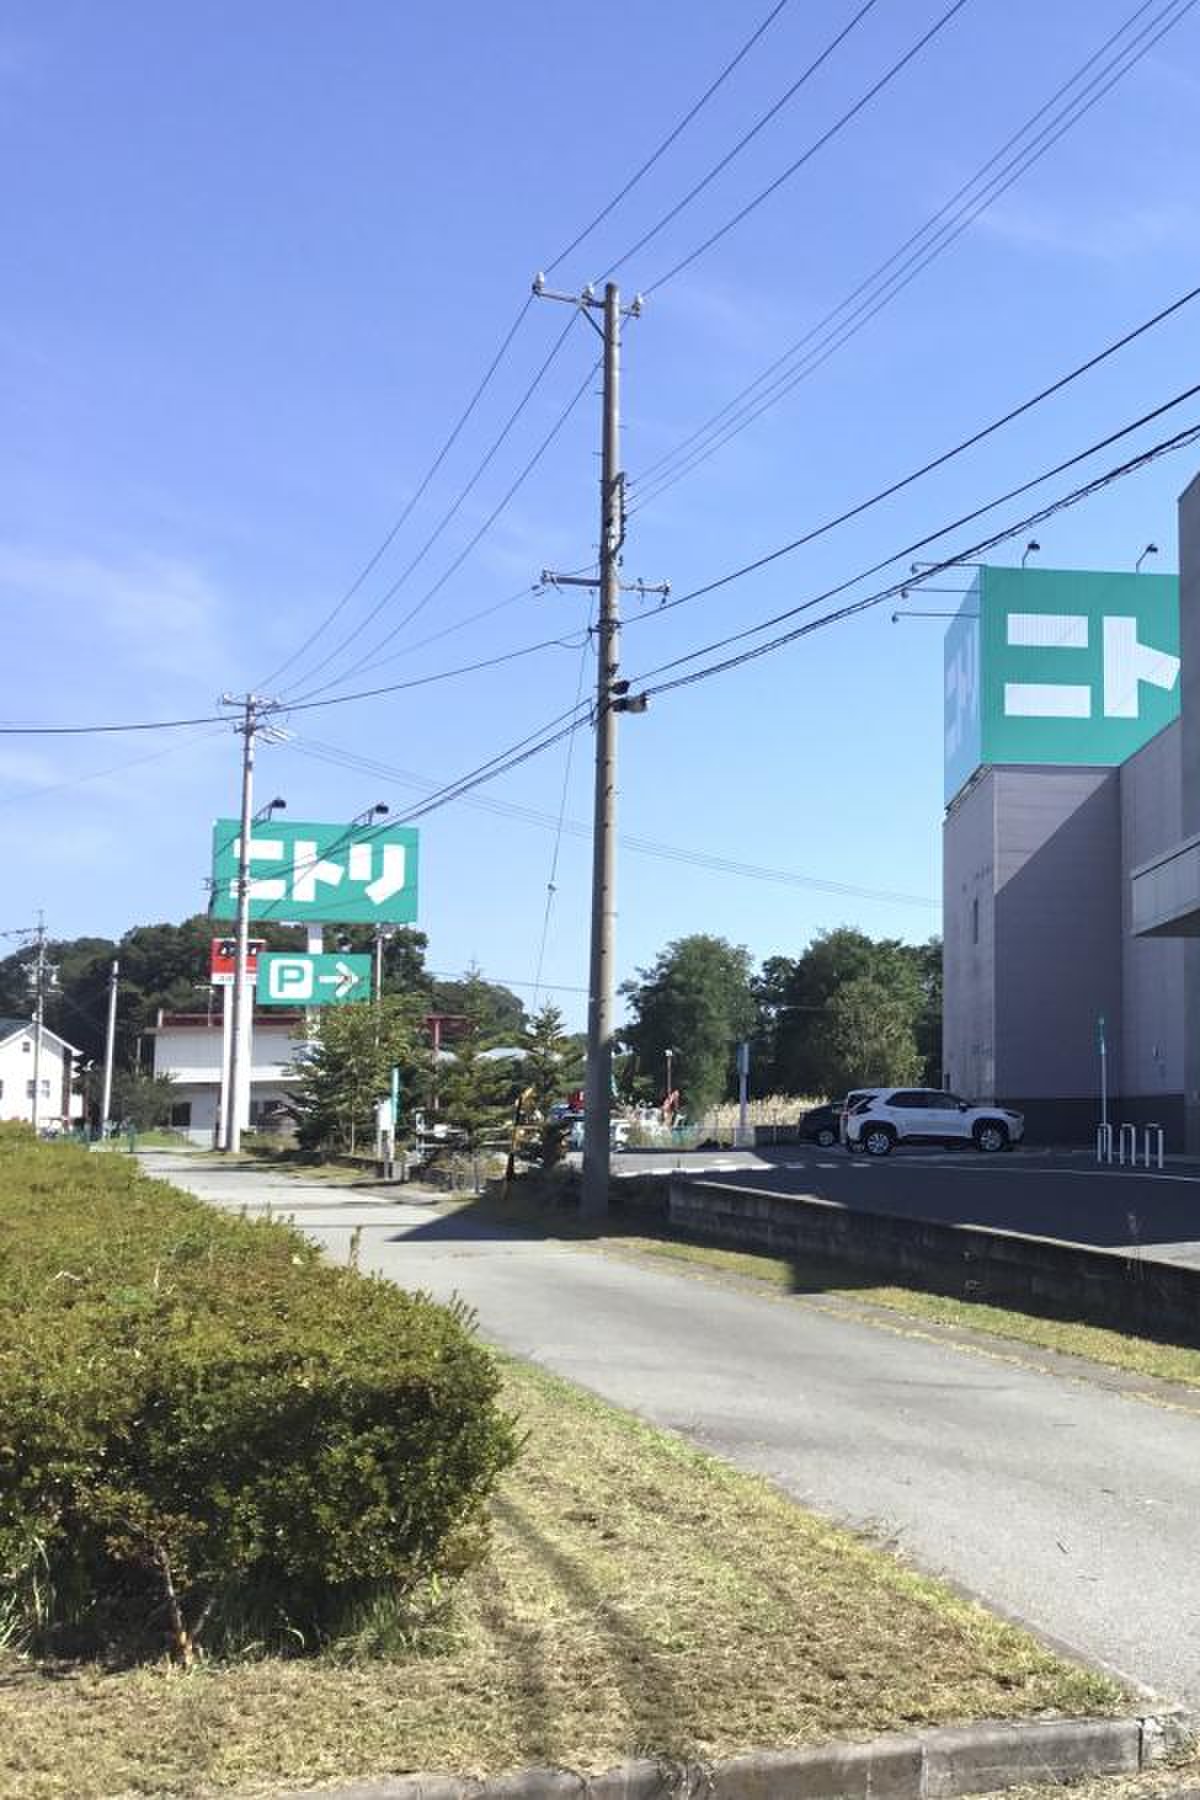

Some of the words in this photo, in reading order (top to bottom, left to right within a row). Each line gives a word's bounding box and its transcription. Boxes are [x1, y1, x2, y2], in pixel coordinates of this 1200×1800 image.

[229, 838, 405, 905] ニトリ
[277, 964, 305, 993] P
